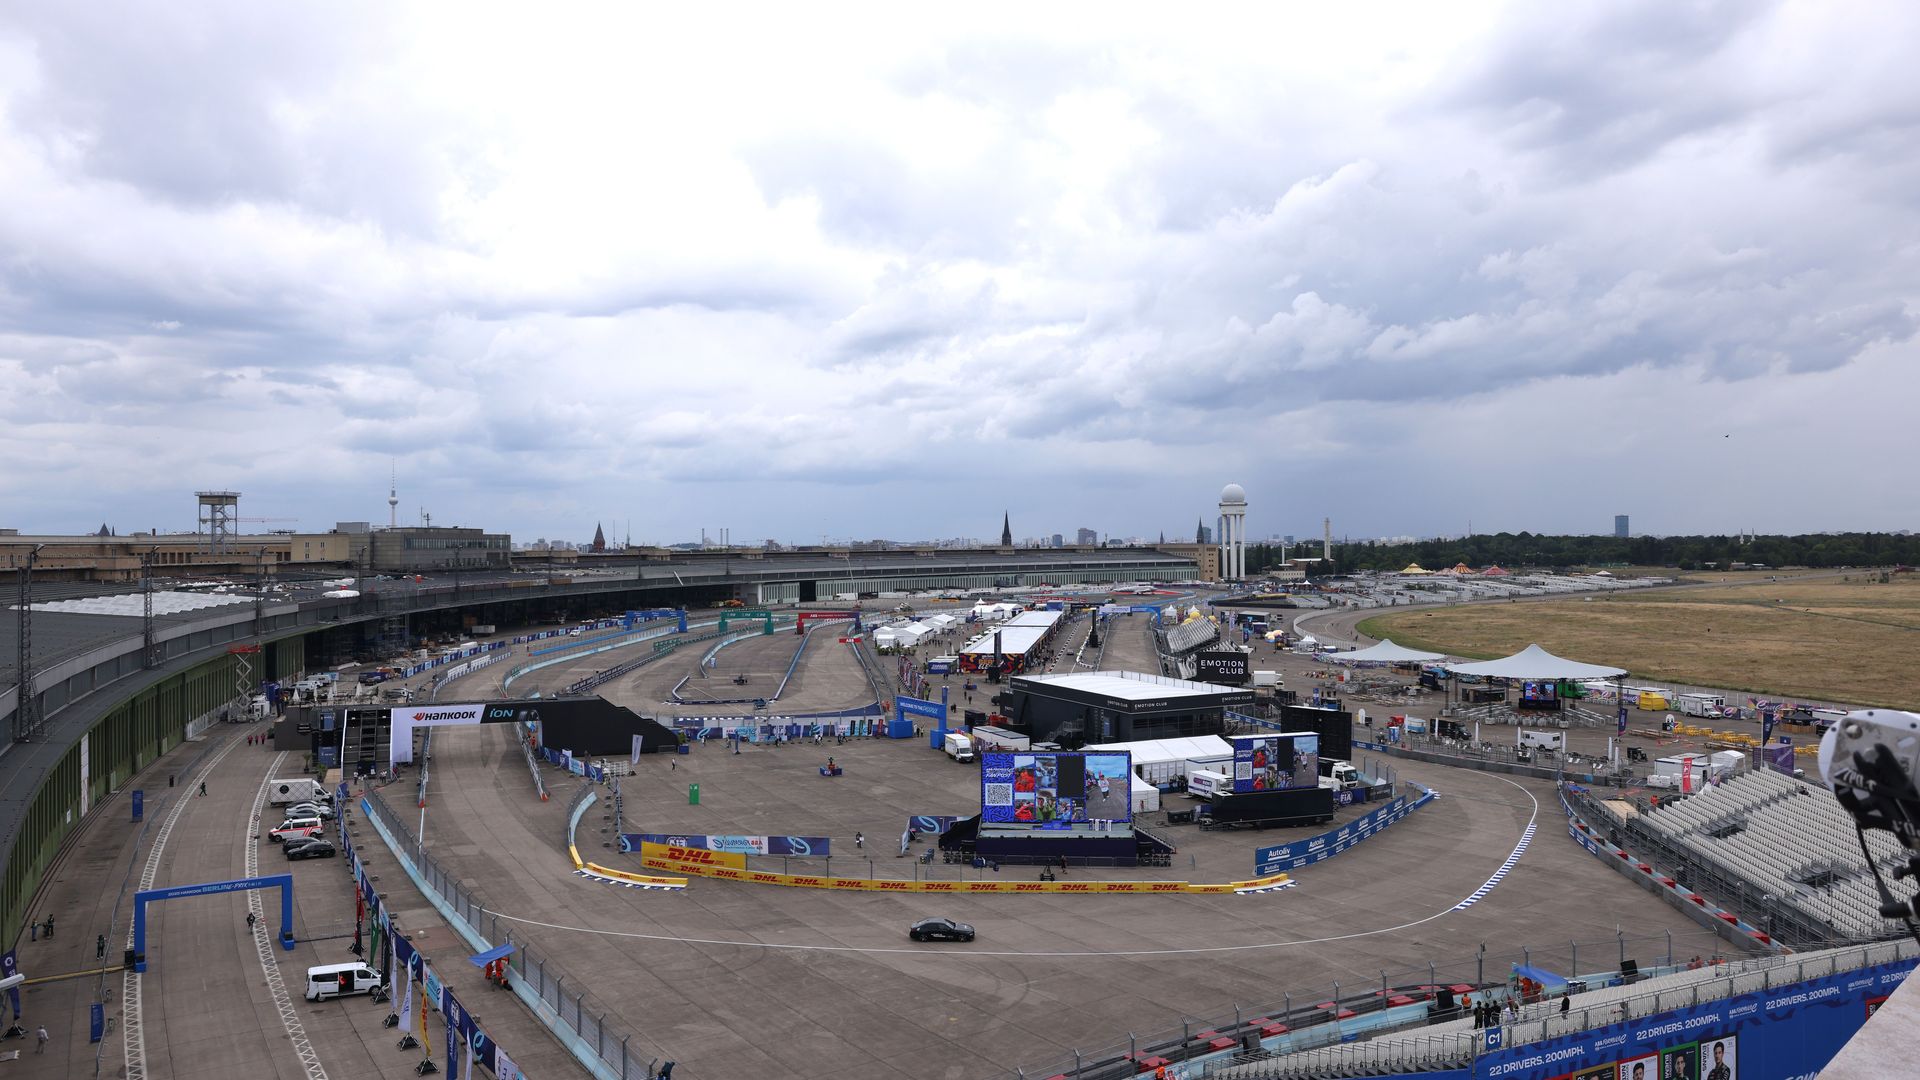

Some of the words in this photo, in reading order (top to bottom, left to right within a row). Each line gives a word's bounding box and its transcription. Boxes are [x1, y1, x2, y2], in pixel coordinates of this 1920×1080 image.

[1200, 660, 1244, 668] EMOTION
[424, 711, 476, 720] HANKOOK
[1309, 838, 1325, 849] Autoliv
[667, 848, 715, 864] DHL
[1268, 848, 1290, 858] Autoliv
[648, 860, 667, 868] DHL
[680, 865, 701, 873] DHL
[715, 870, 737, 878] DHL
[1881, 975, 1890, 983] 22
[1766, 1001, 1775, 1010] 22
[1776, 994, 1808, 1007] DRIVERS.
[1809, 986, 1840, 1000] 200MPH.
[1636, 1032, 1647, 1040] 22
[1648, 1022, 1684, 1038] DRIVERS.
[1685, 1014, 1720, 1028] 200MPH.
[1488, 1033, 1501, 1045] C1
[1489, 1067, 1502, 1076] 22
[1503, 1056, 1544, 1073] DRIVERS.
[1545, 1045, 1585, 1064] 200MPH.
